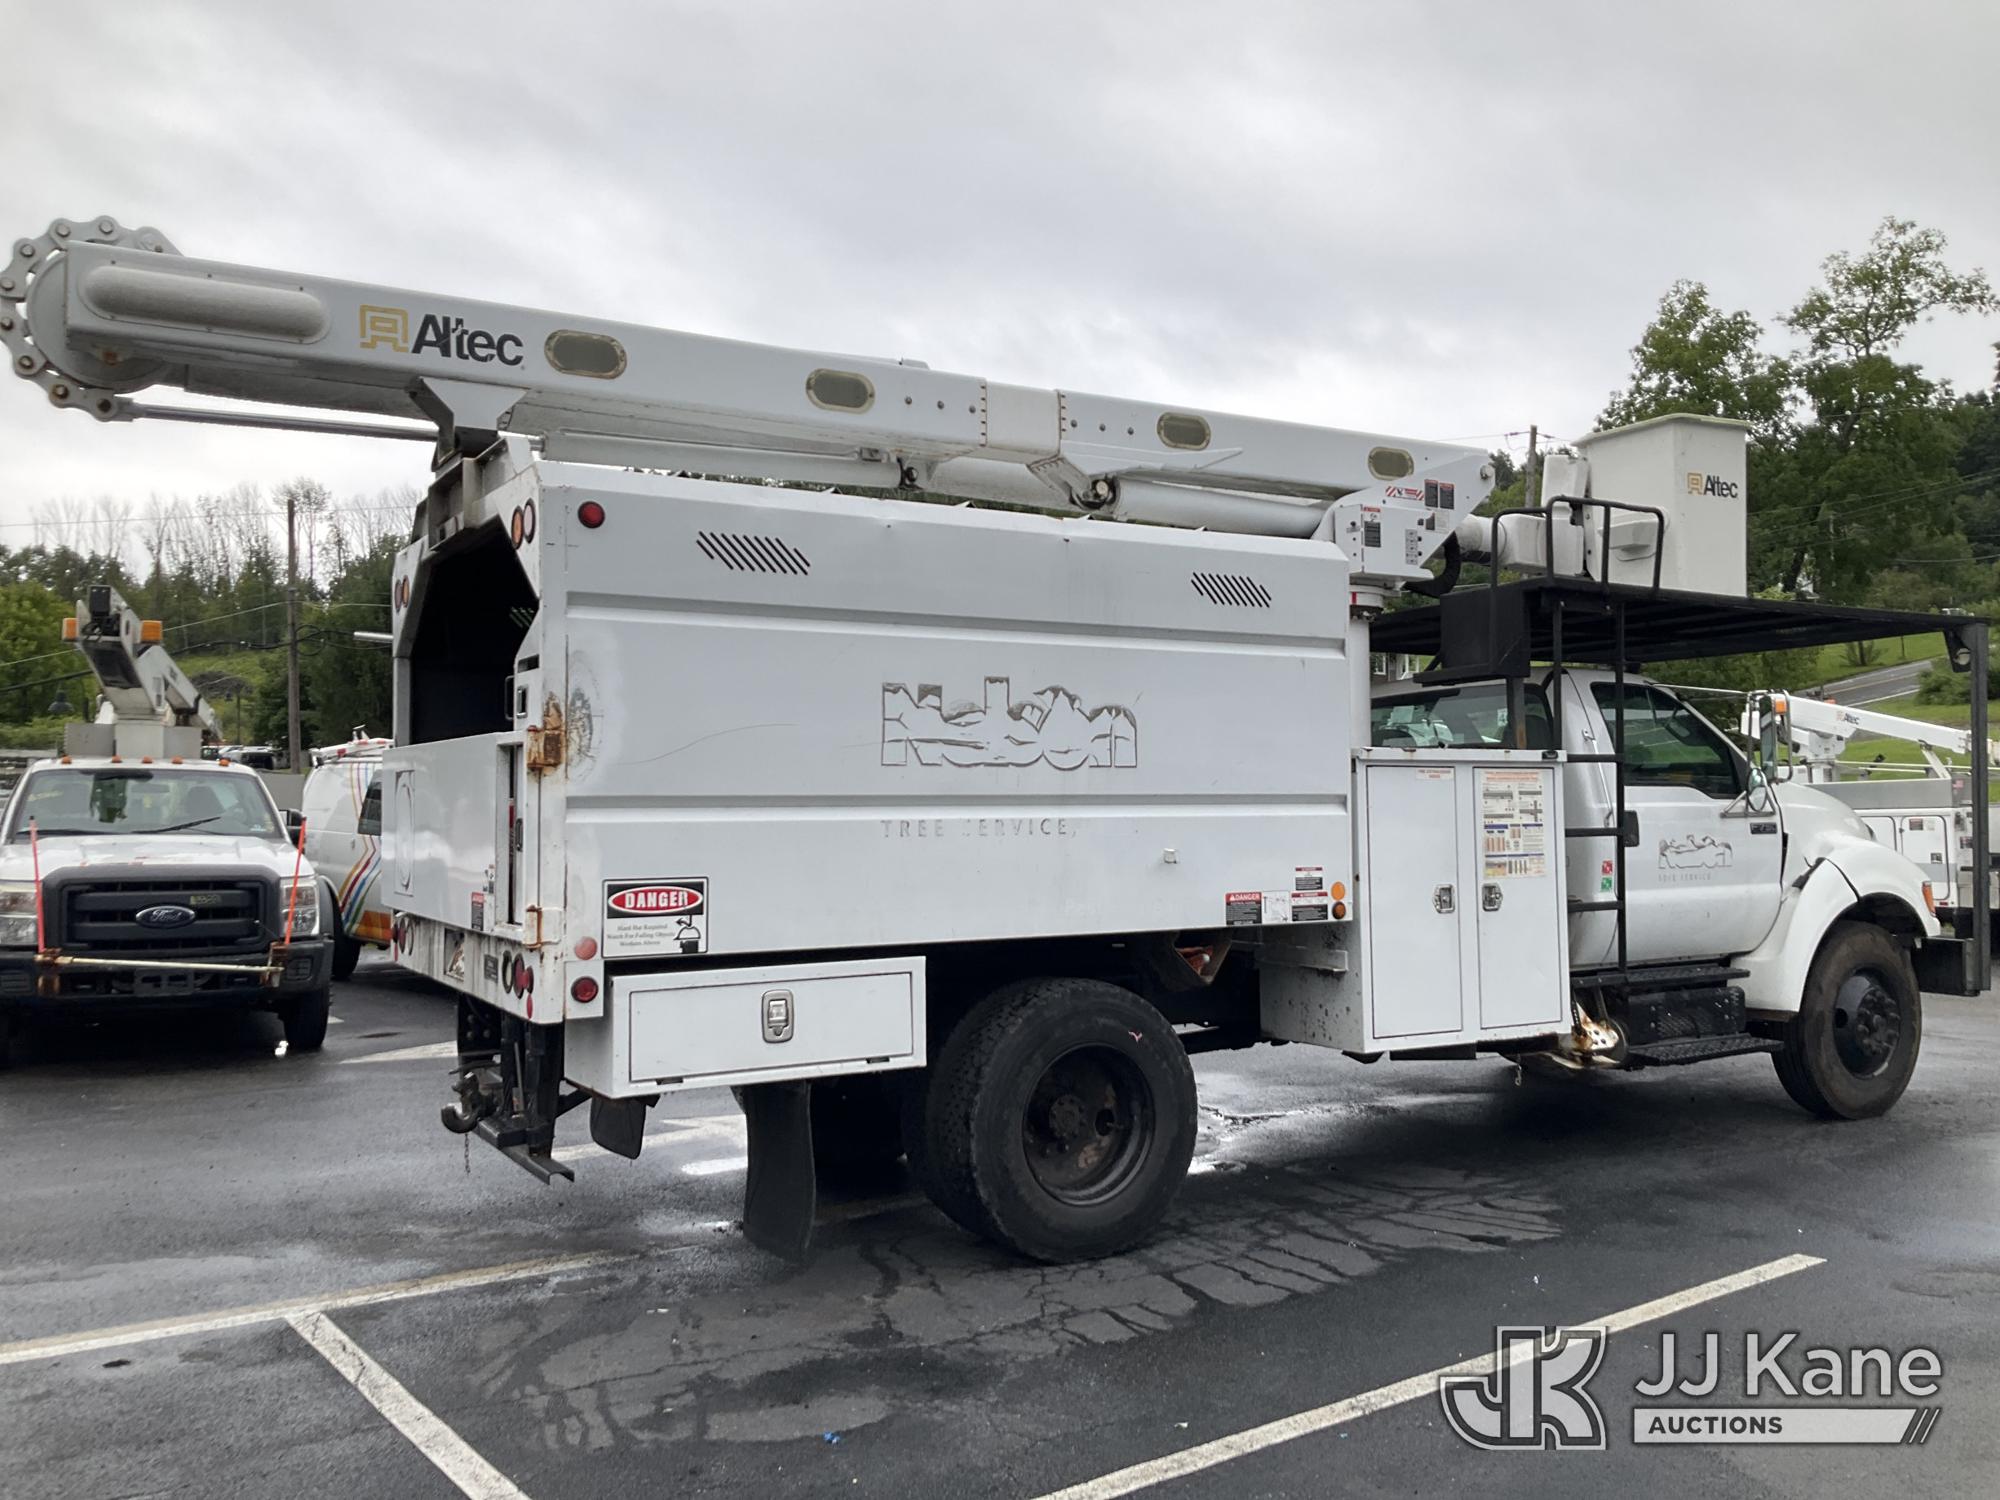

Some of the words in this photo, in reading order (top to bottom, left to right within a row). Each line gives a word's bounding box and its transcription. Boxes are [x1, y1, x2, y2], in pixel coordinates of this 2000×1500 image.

[411, 313, 524, 367] Altec
[1703, 474, 1738, 498] Altec
[880, 819, 944, 838] TREE
[625, 890, 689, 909] DANGER
[1235, 893, 1260, 901] DANGER
